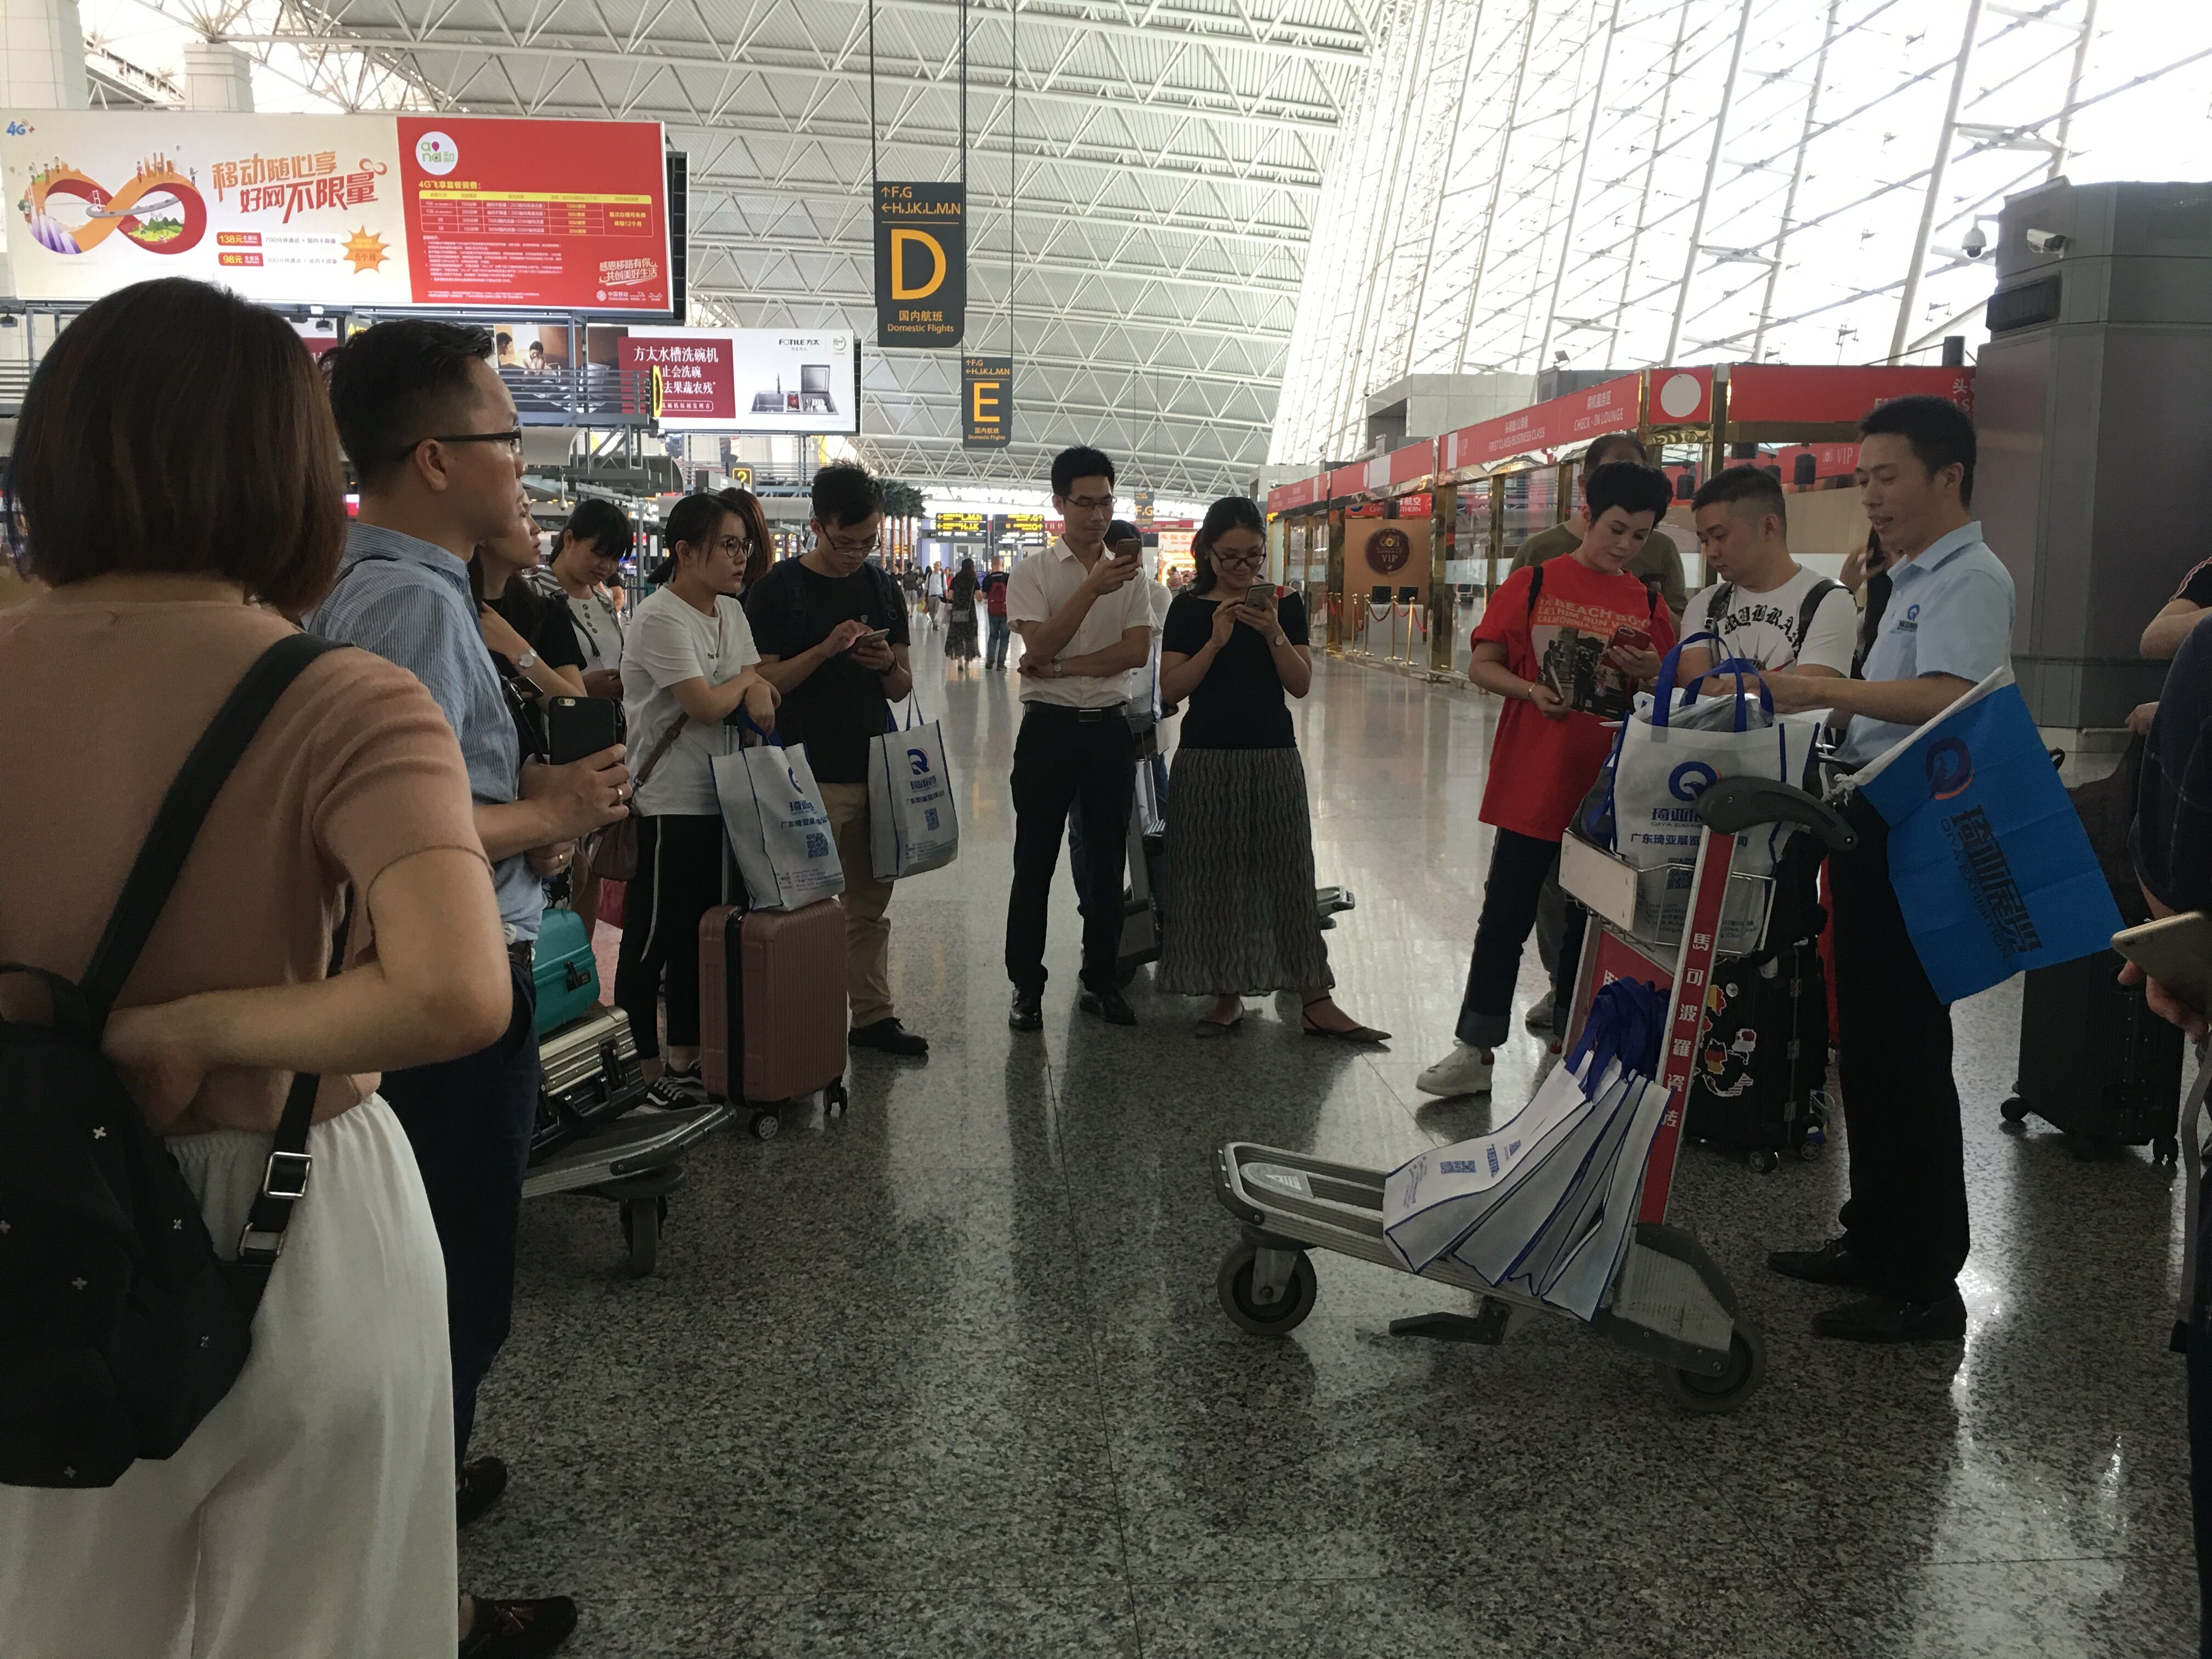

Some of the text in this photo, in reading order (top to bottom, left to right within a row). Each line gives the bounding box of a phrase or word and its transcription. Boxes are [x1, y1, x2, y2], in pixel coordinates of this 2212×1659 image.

[212, 151, 337, 202] 移动随心享
[240, 171, 379, 224] 好网不限量
[219, 234, 242, 244] 138元
[223, 255, 242, 264] 98元
[891, 229, 946, 300] D
[606, 267, 657, 281] 共创美好生活
[899, 310, 943, 321] 国内航班
[887, 324, 954, 334] Domestic Flights
[634, 346, 719, 363] 方太水槽洗碗机
[658, 365, 702, 378] 止会洗碗
[662, 380, 715, 394] 去果蔬农残
[974, 382, 1000, 422] E
[1574, 416, 1590, 432] CHECK
[1601, 408, 1623, 425] LOUNGE
[1458, 438, 1468, 456] VIP
[1837, 447, 1853, 465] VIP
[1381, 554, 1398, 562] VIP
[1555, 597, 1612, 619] BEACH
[1537, 615, 1590, 629] CALIFORNIA
[1557, 608, 1578, 619] HIM
[1583, 614, 1608, 626] RUN
[1940, 817, 2008, 960] QIYA EXHIBITION
